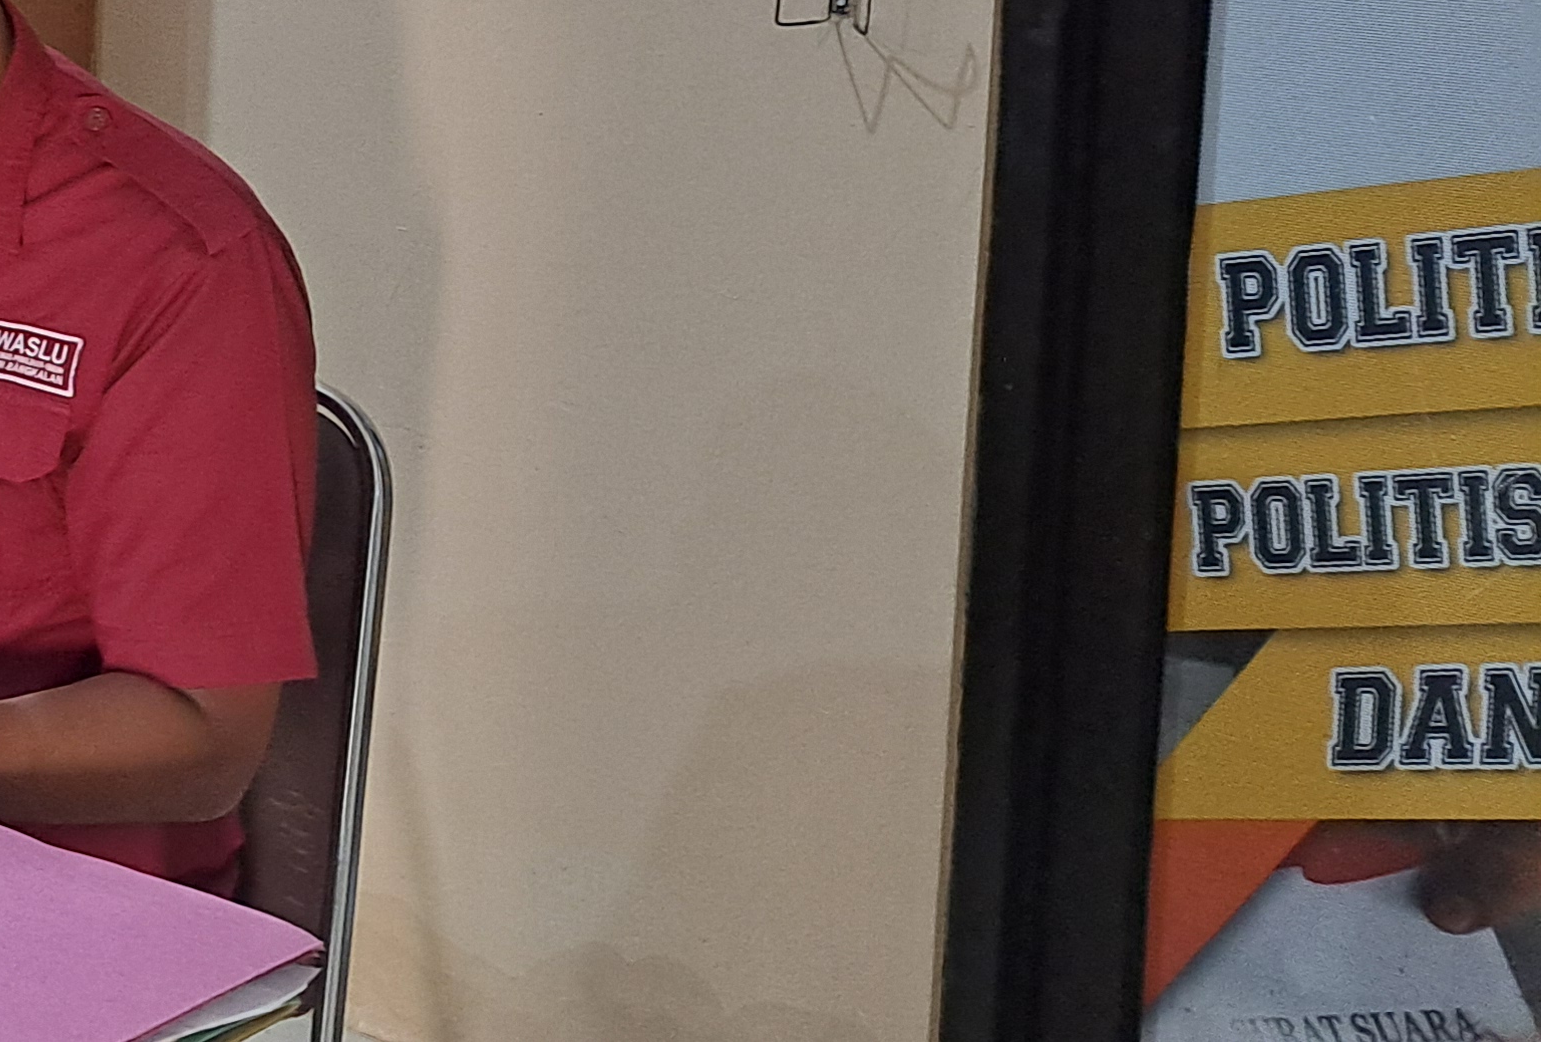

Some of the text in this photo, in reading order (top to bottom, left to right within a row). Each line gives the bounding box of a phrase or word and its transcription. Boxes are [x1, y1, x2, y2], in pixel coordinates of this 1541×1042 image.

[1188, 462, 1541, 578] POLITIS
[1328, 661, 1541, 772] DAN
[1229, 1013, 1344, 1042] RAT
